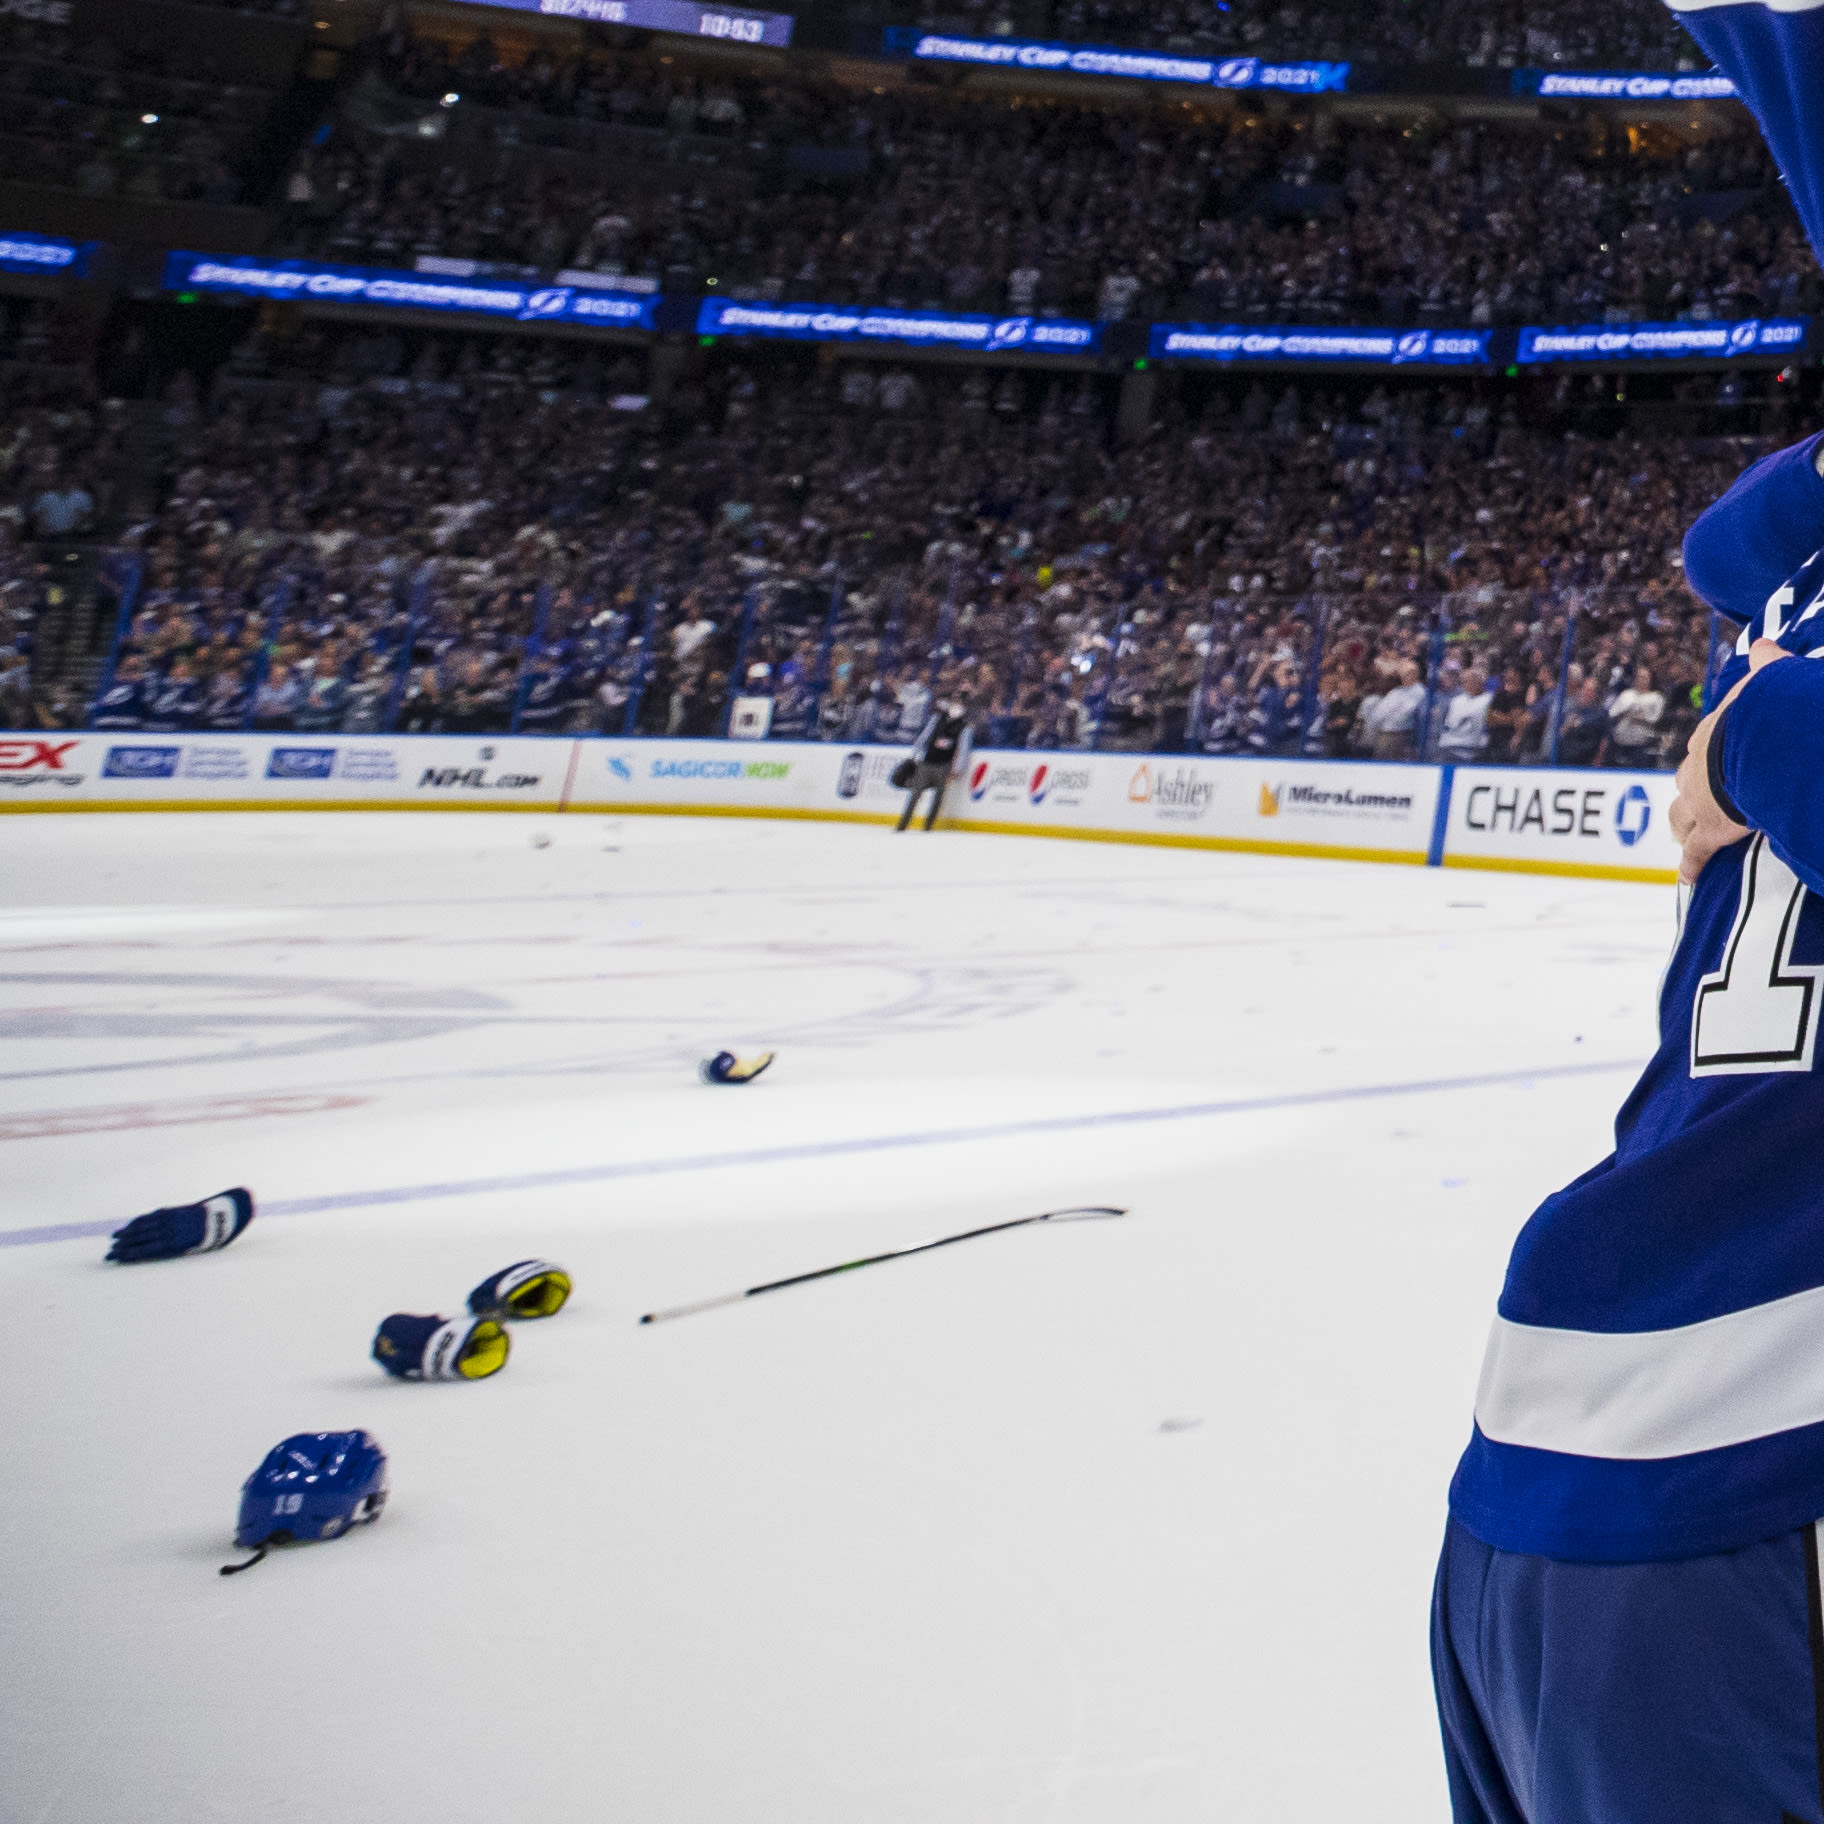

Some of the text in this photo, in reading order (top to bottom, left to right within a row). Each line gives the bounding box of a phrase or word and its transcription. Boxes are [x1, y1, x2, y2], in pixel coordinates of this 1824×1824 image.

[915, 35, 1018, 63] STANLEY
[1539, 74, 1626, 95] STANLEY
[1151, 766, 1216, 810] Ashley
[1464, 785, 1606, 837] CHASE
